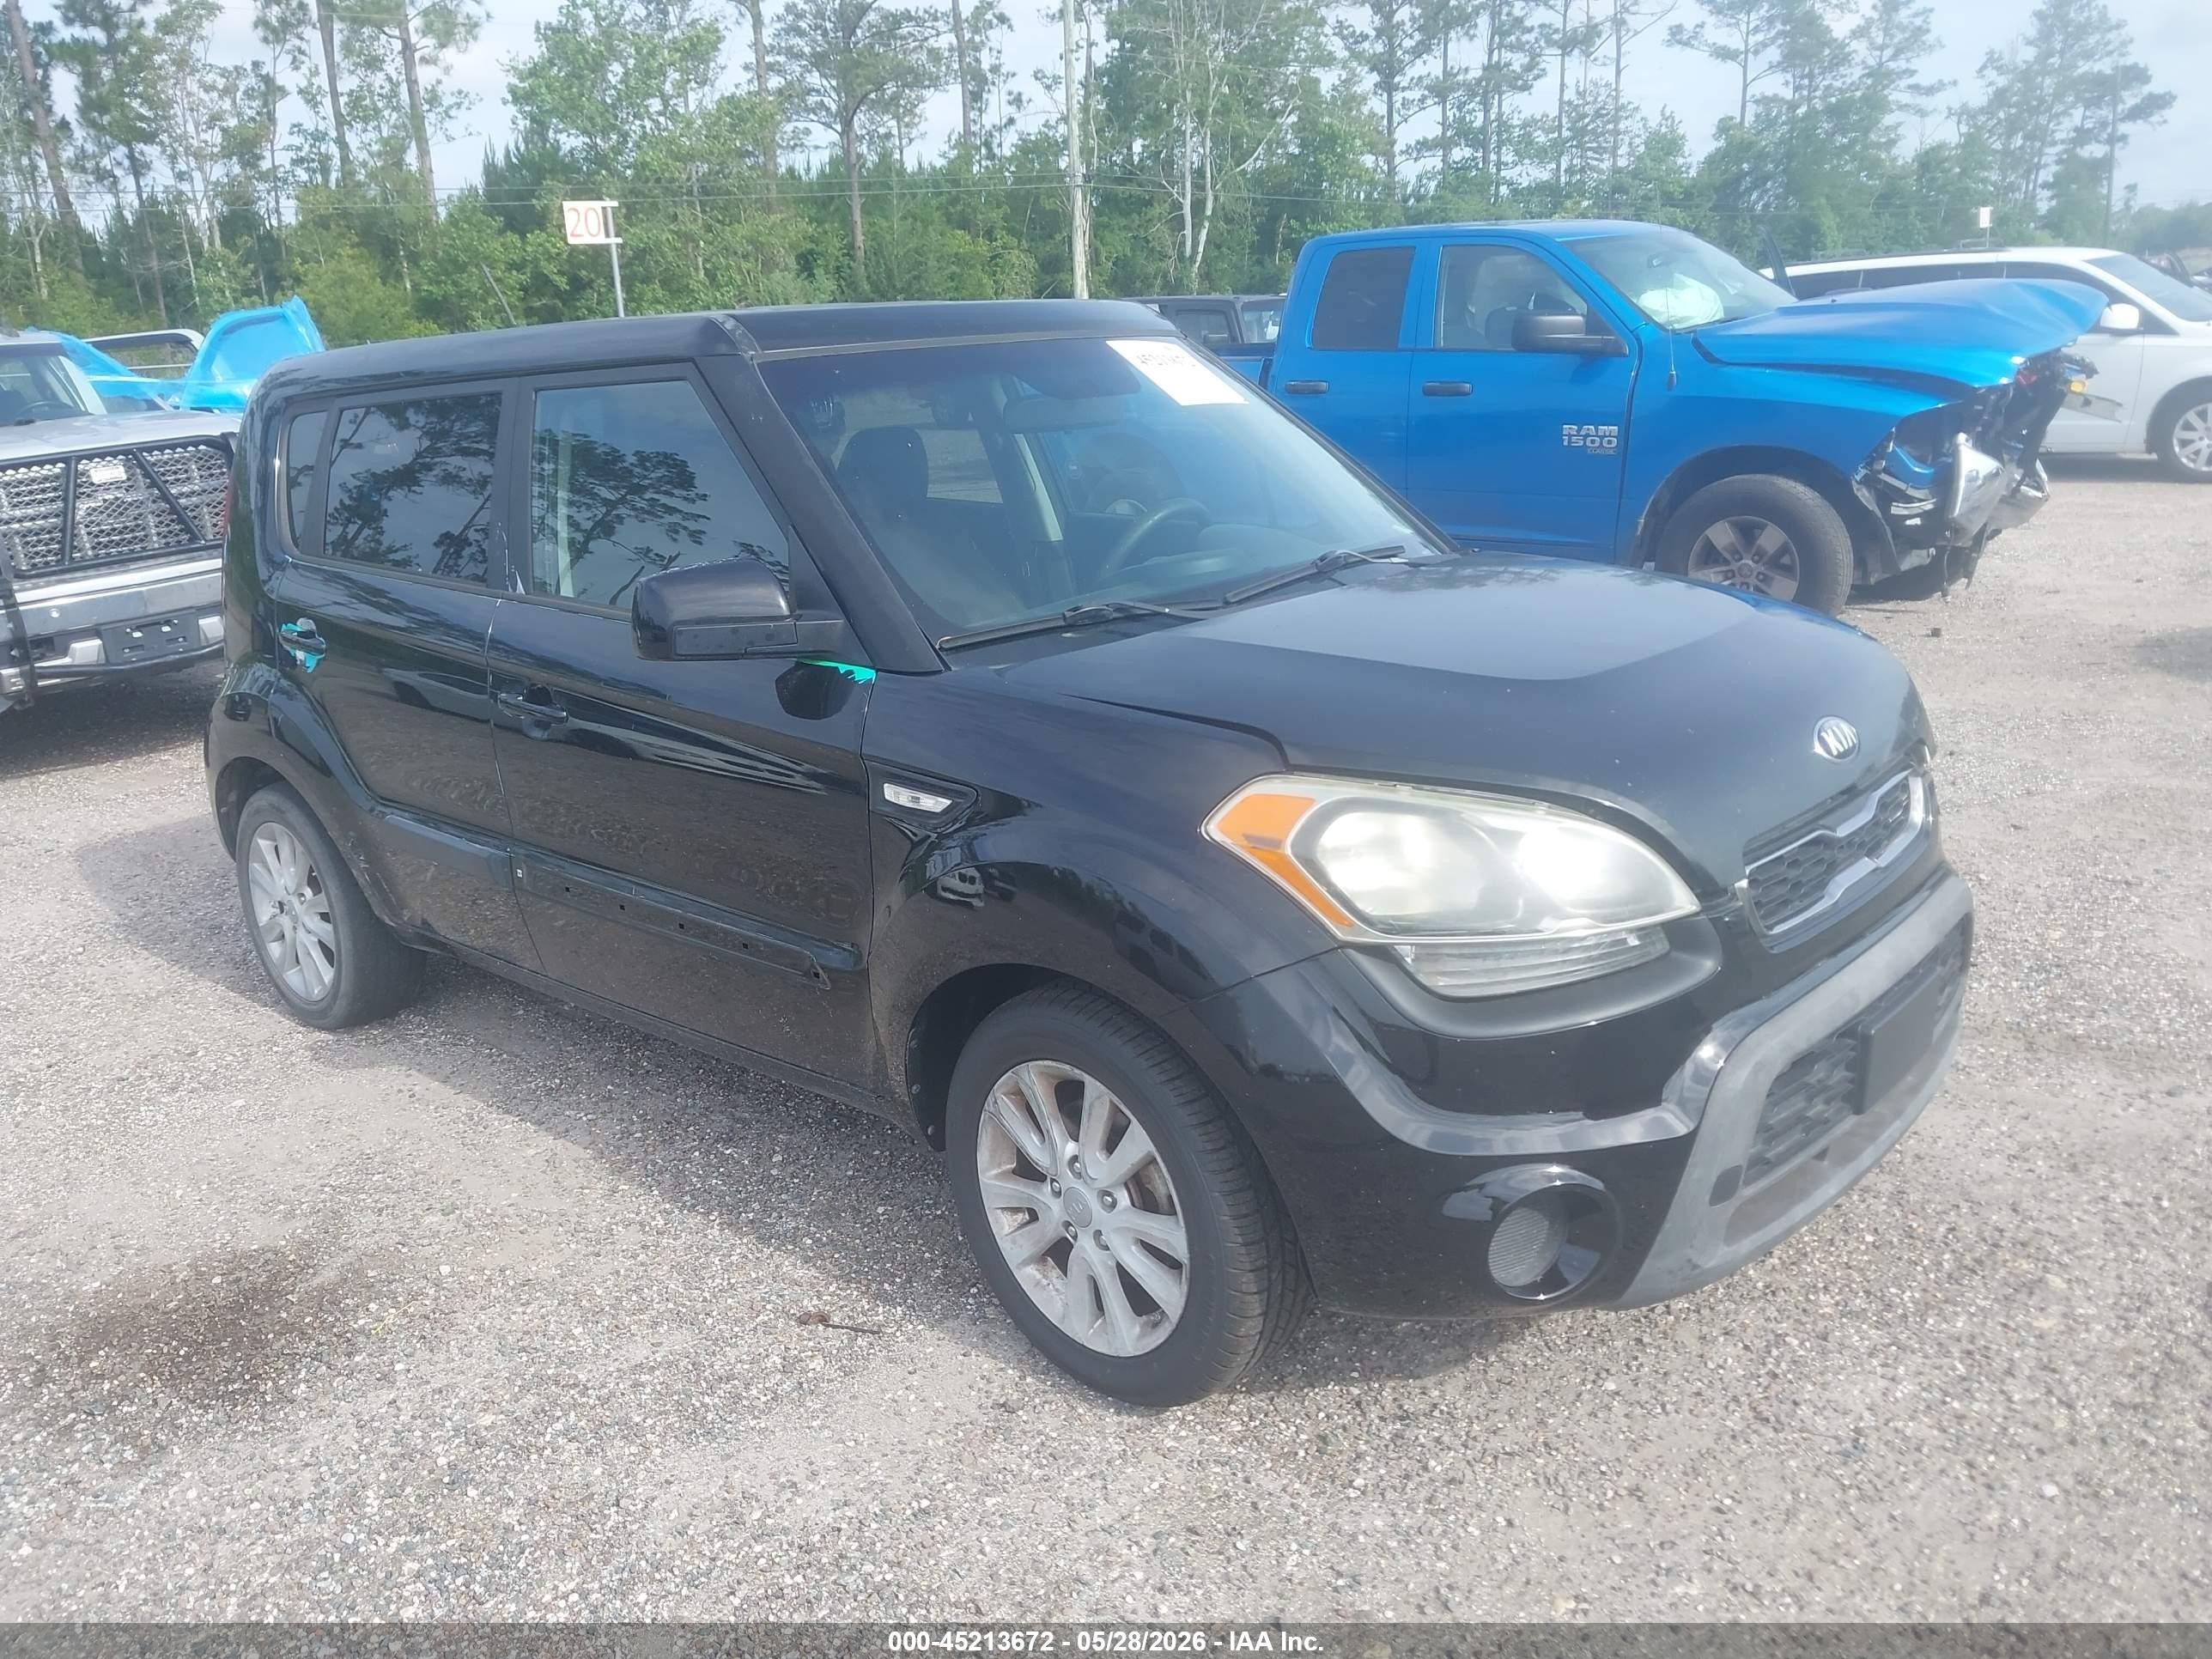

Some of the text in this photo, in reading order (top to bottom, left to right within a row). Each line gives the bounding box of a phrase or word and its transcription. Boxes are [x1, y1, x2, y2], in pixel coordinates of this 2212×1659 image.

[567, 207, 601, 238] 20
[1562, 424, 1619, 436] RAM
[1562, 435, 1618, 447] 1500
